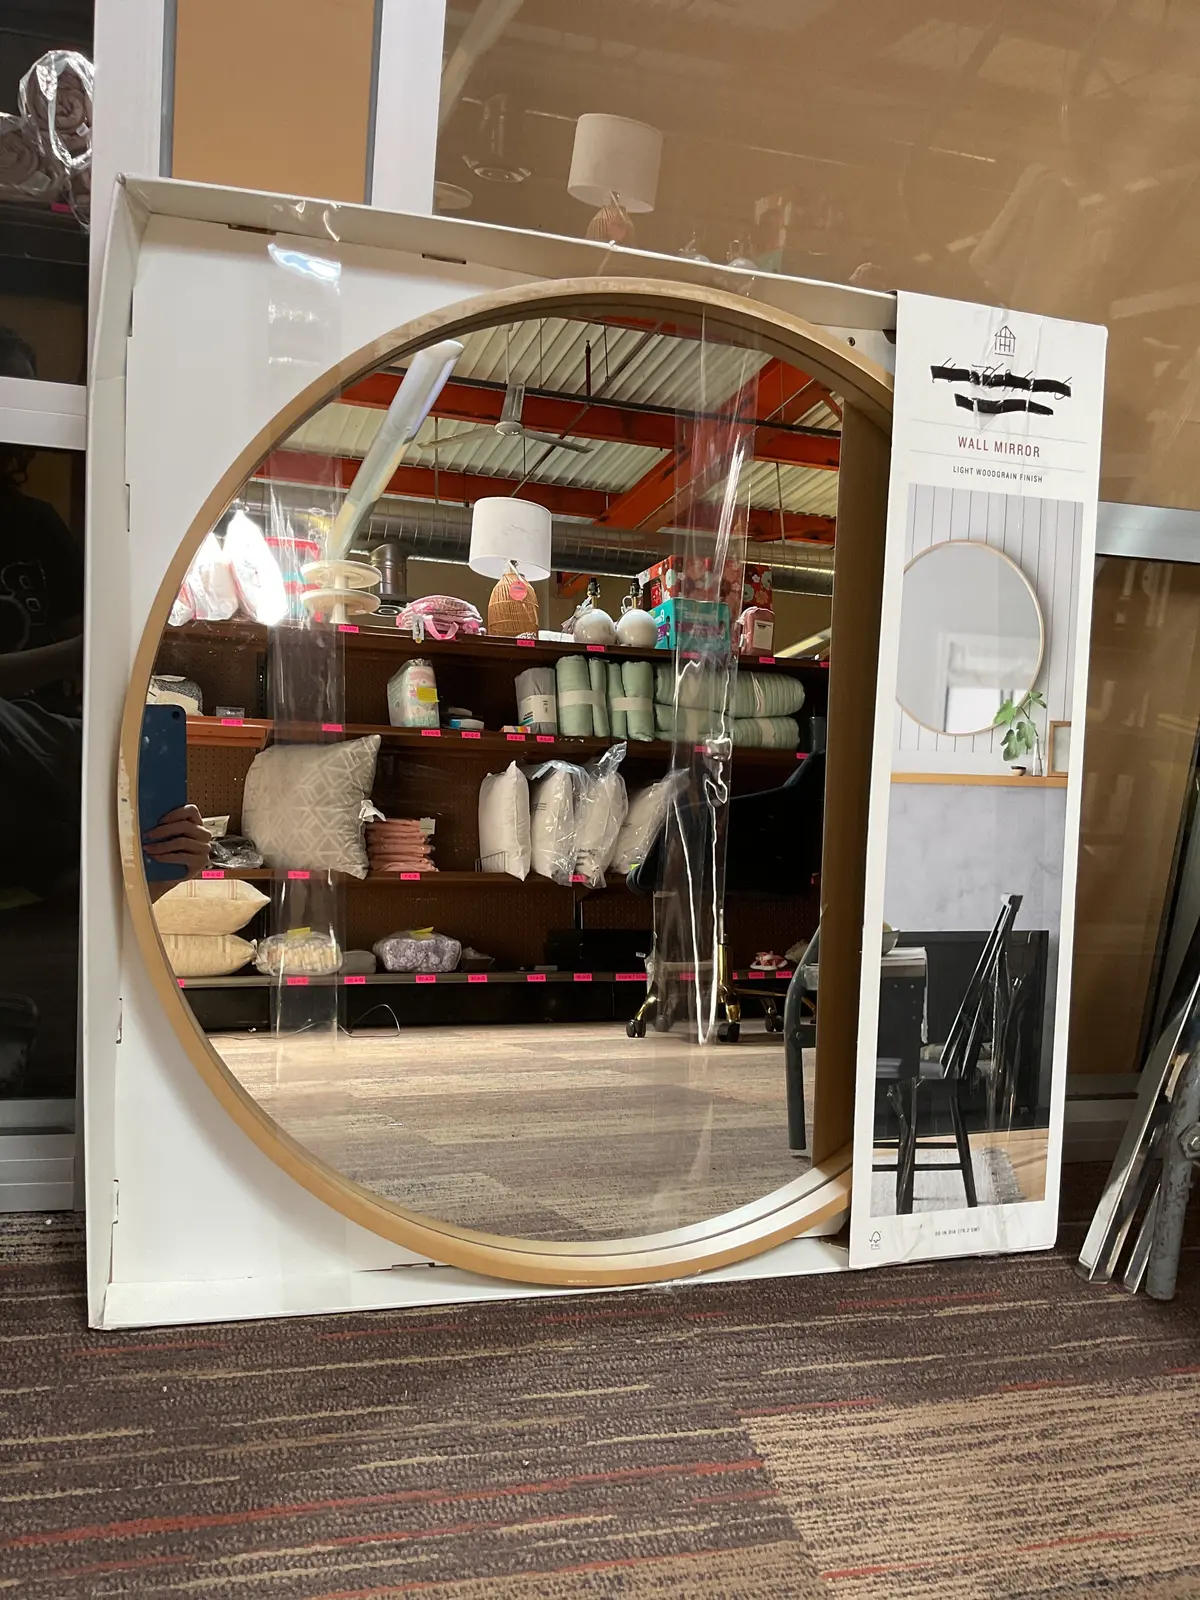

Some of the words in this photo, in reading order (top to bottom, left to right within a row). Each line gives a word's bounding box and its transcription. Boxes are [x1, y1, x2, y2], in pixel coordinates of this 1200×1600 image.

[958, 436, 989, 451] WALL
[994, 441, 1040, 458] MIRROR
[952, 465, 974, 475] LIGHT
[976, 468, 1018, 480] WOODGRAIN
[1019, 473, 1043, 483] FINISH
